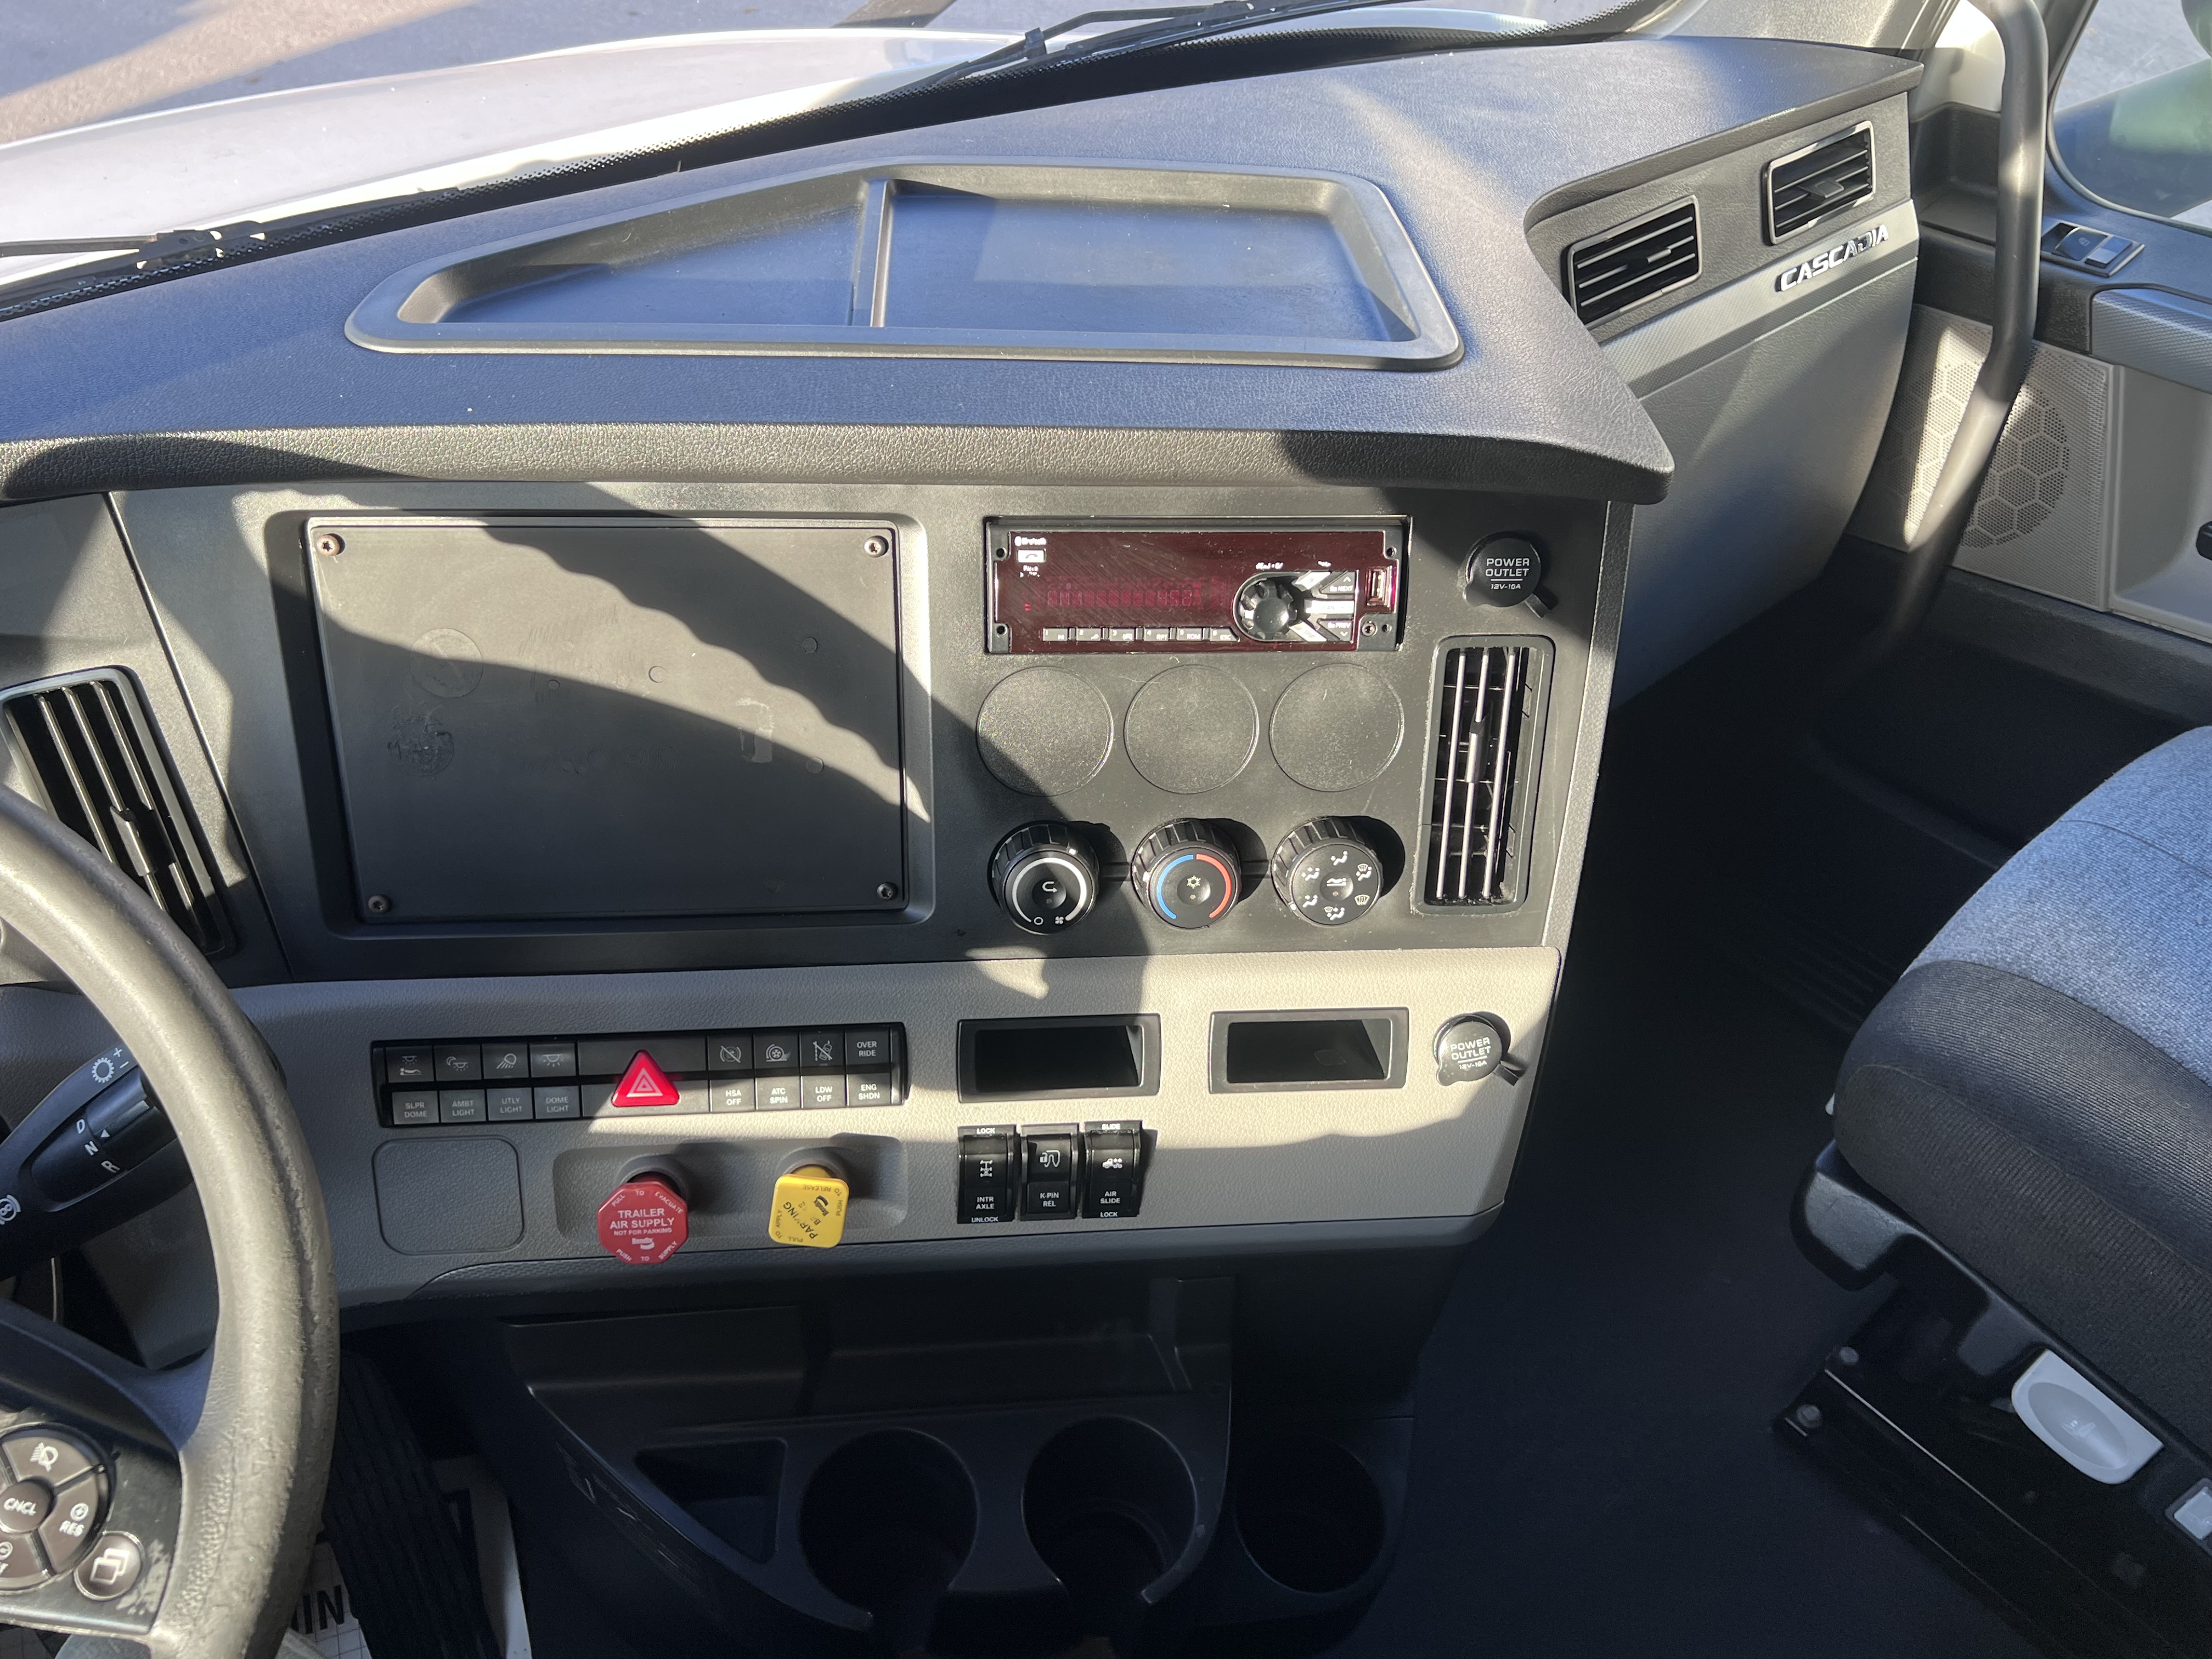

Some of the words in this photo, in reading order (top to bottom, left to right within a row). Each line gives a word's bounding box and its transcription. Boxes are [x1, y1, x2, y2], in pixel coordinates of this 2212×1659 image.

[1781, 224, 1889, 291] CASCADIA
[1486, 558, 1530, 566] POWER
[1485, 568, 1530, 577] OUTLET
[1450, 1037, 1491, 1052] POWER
[1451, 1046, 1491, 1060] OUTLET
[76, 1119, 85, 1135] D
[84, 1141, 99, 1155] N
[101, 1160, 120, 1173] R
[834, 1188, 842, 1197] TO
[611, 1194, 625, 1207] PULL
[654, 1191, 684, 1214] EVACUATE
[618, 1208, 665, 1218] TRAILER
[783, 1201, 818, 1239] PARING
[610, 1221, 629, 1229] AIR
[631, 1217, 674, 1228] SUPPLY
[616, 1249, 632, 1262] PUSH
[658, 1241, 678, 1260] SUPPLY
[4, 1497, 37, 1516] CNCL
[59, 1520, 84, 1537] RES
[291, 1584, 344, 1634] IN
